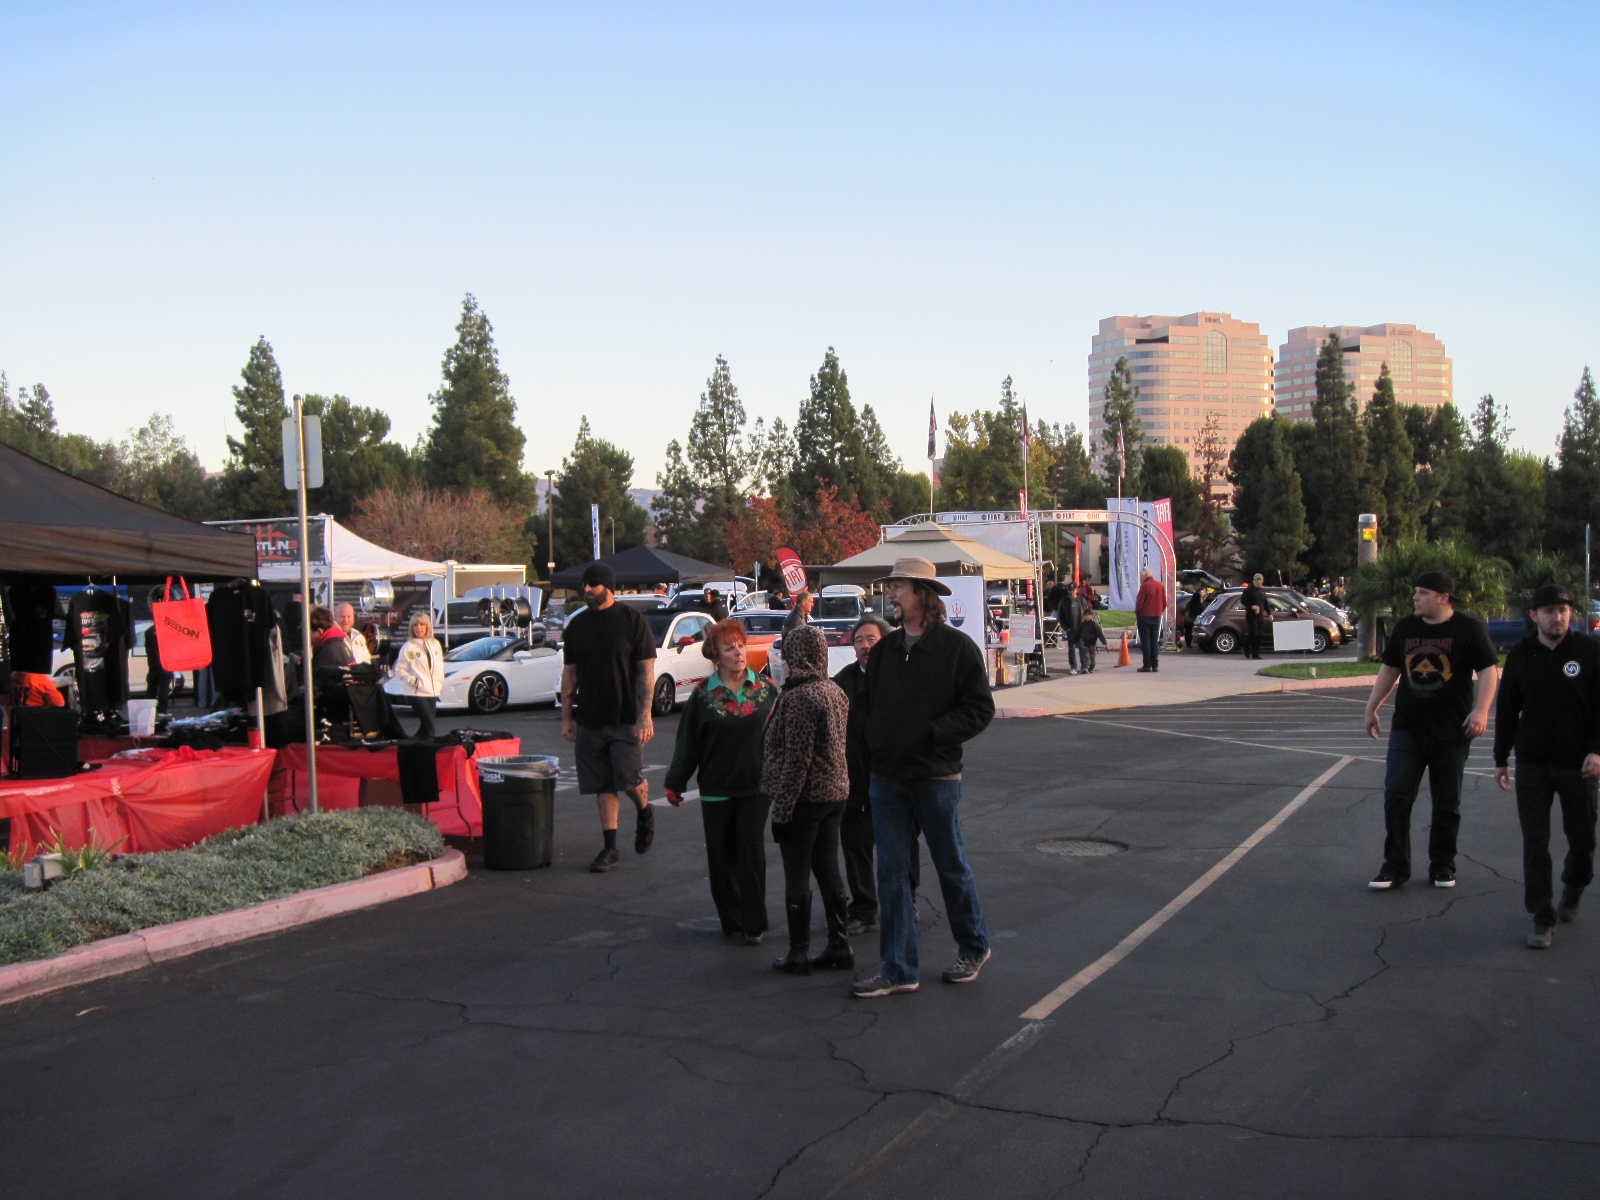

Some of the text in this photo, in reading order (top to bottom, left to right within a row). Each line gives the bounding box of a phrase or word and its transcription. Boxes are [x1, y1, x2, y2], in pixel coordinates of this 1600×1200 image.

[987, 513, 1001, 521] FIAT
[1062, 512, 1075, 520] FIAT
[784, 567, 803, 588] FIAT
[163, 615, 200, 639] SEBON
